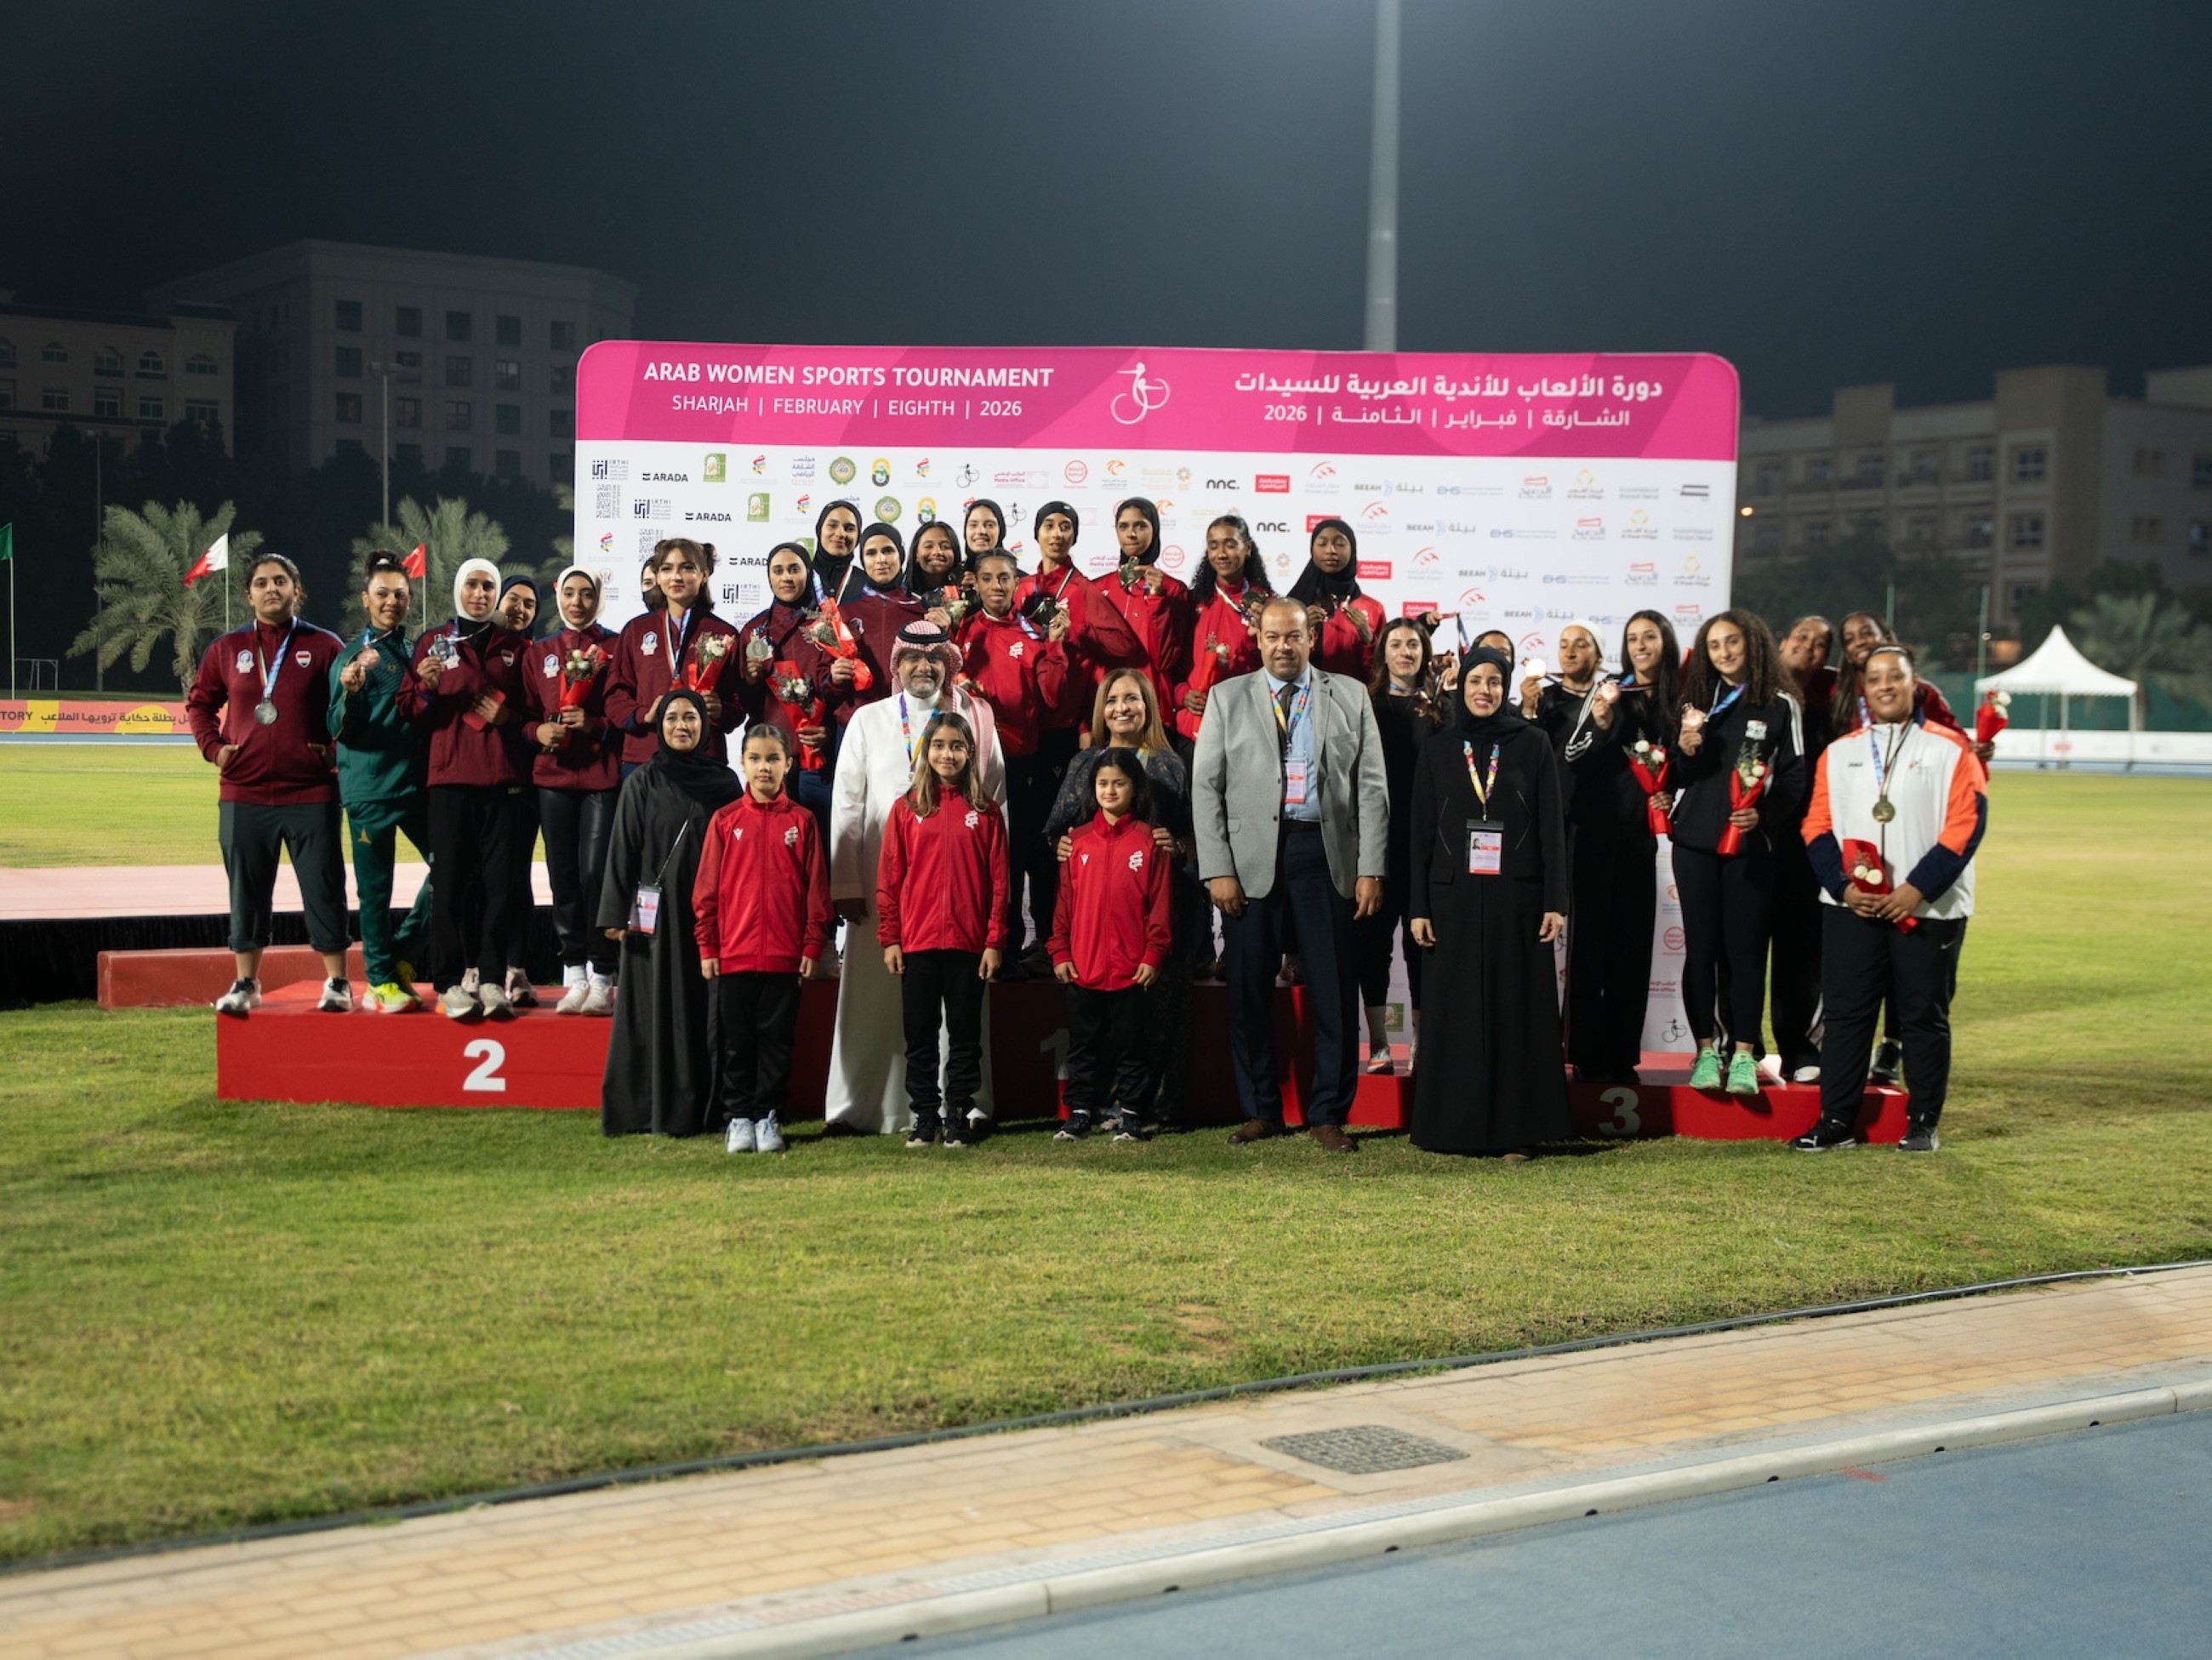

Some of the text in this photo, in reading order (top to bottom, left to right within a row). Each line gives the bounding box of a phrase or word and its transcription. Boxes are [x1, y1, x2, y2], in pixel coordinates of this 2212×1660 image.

[644, 362, 1054, 387] ARAB WOMEN SPORTS TOURNAMENT
[1234, 372, 1662, 402] دورة الألعاب للأندية العربية للسيدات
[672, 395, 749, 415] SHARJAH
[773, 397, 864, 416] FEBRUARY
[888, 399, 955, 416] EIGHTH
[980, 401, 1023, 417] 2026
[1263, 404, 1308, 422] 2026
[1331, 405, 1422, 425] الثامنة
[1444, 409, 1518, 430] فبراير
[1542, 408, 1630, 431] الشارقة
[653, 472, 689, 482] ARADA
[1206, 479, 1240, 490] nnc.
[696, 512, 732, 522] ARADA
[1257, 522, 1291, 533] nnc.
[740, 557, 768, 567] ARAD
[41, 712, 79, 724] الملاعب
[82, 713, 117, 724] ترويها
[119, 713, 151, 725] حكاية
[151, 712, 176, 725] بطلة
[464, 1039, 506, 1092] 2
[1598, 1087, 1641, 1135] 3
